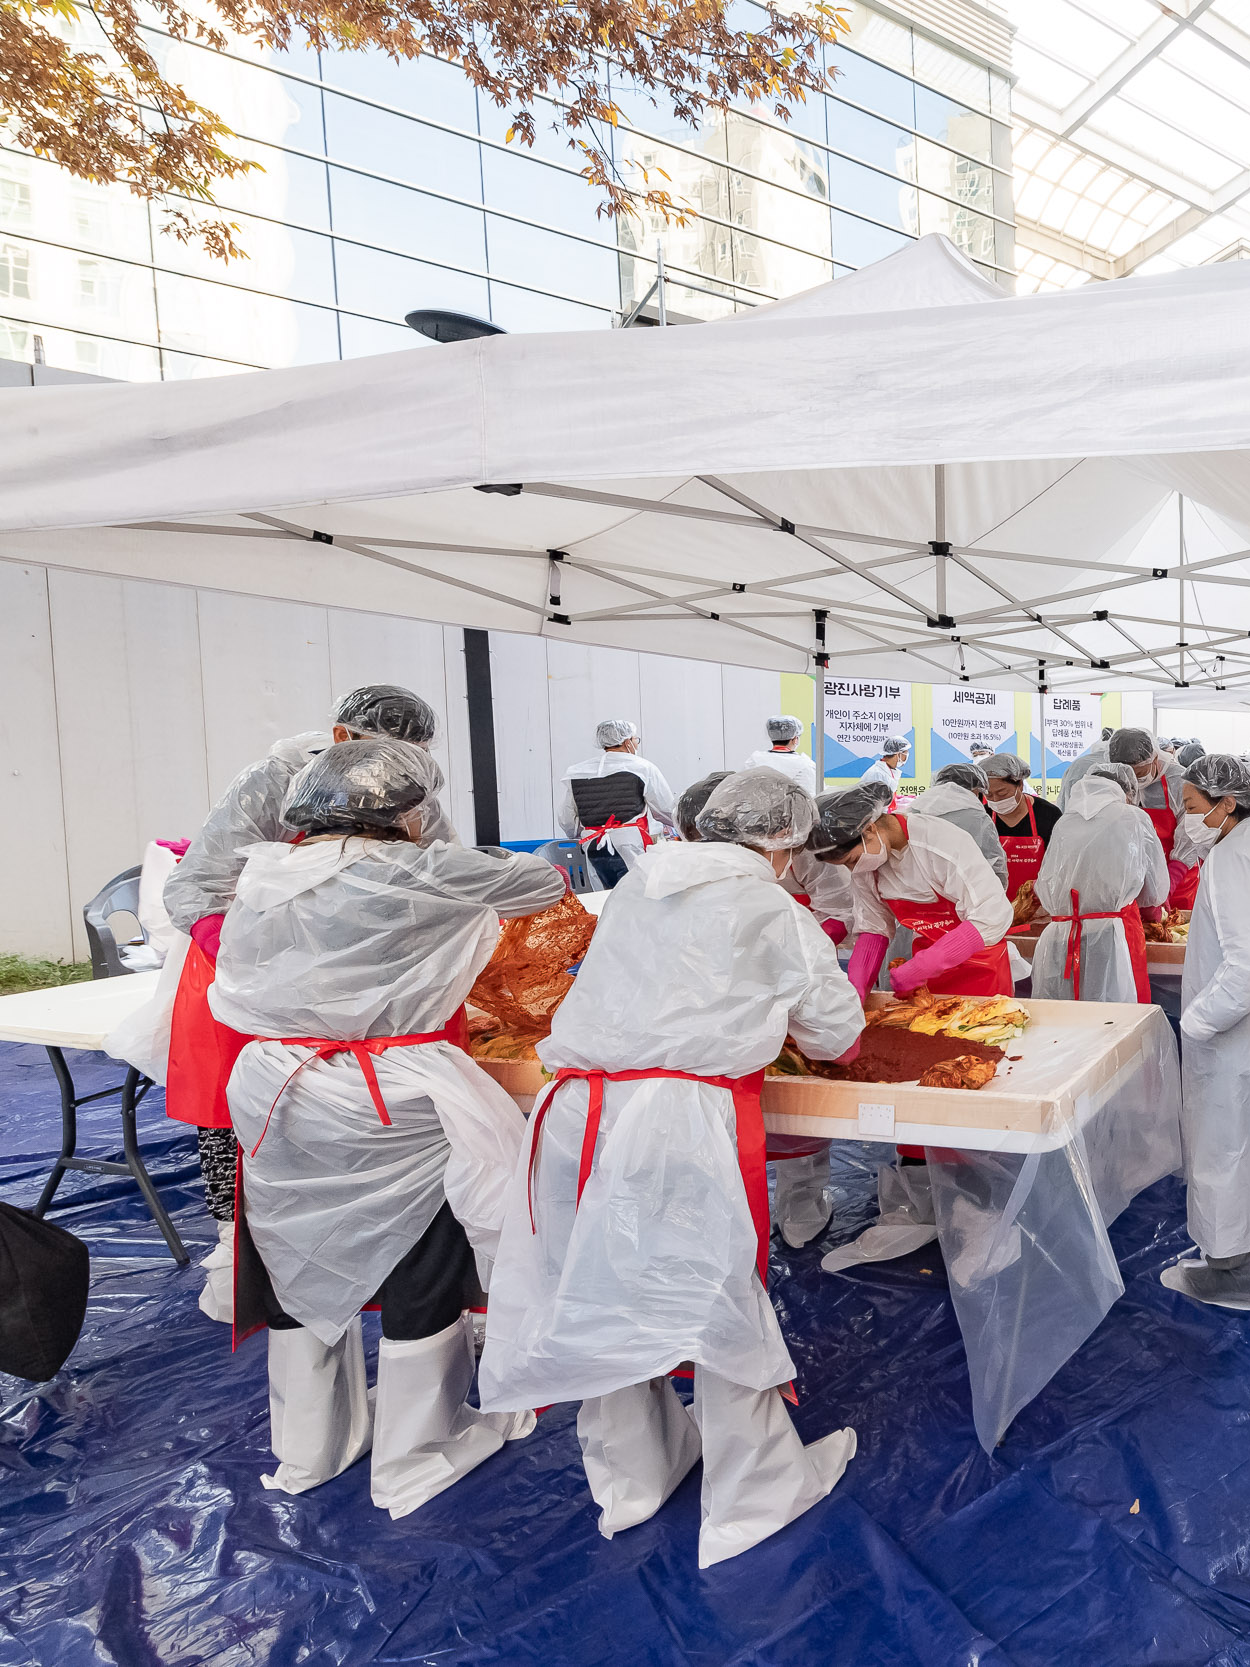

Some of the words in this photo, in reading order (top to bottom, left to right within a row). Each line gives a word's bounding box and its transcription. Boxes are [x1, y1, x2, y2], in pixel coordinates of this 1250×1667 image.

[824, 682, 901, 699] 광진사랑기부
[953, 691, 996, 705] 세액공제
[1053, 698, 1081, 711] 답례품
[825, 709, 851, 720] 개인이
[852, 710, 877, 721] 주소지
[878, 711, 902, 722] 이외의
[839, 721, 872, 732] 지자체에
[873, 723, 889, 732] 기부
[942, 718, 978, 729] 10만원까지
[993, 720, 1007, 730] 공제
